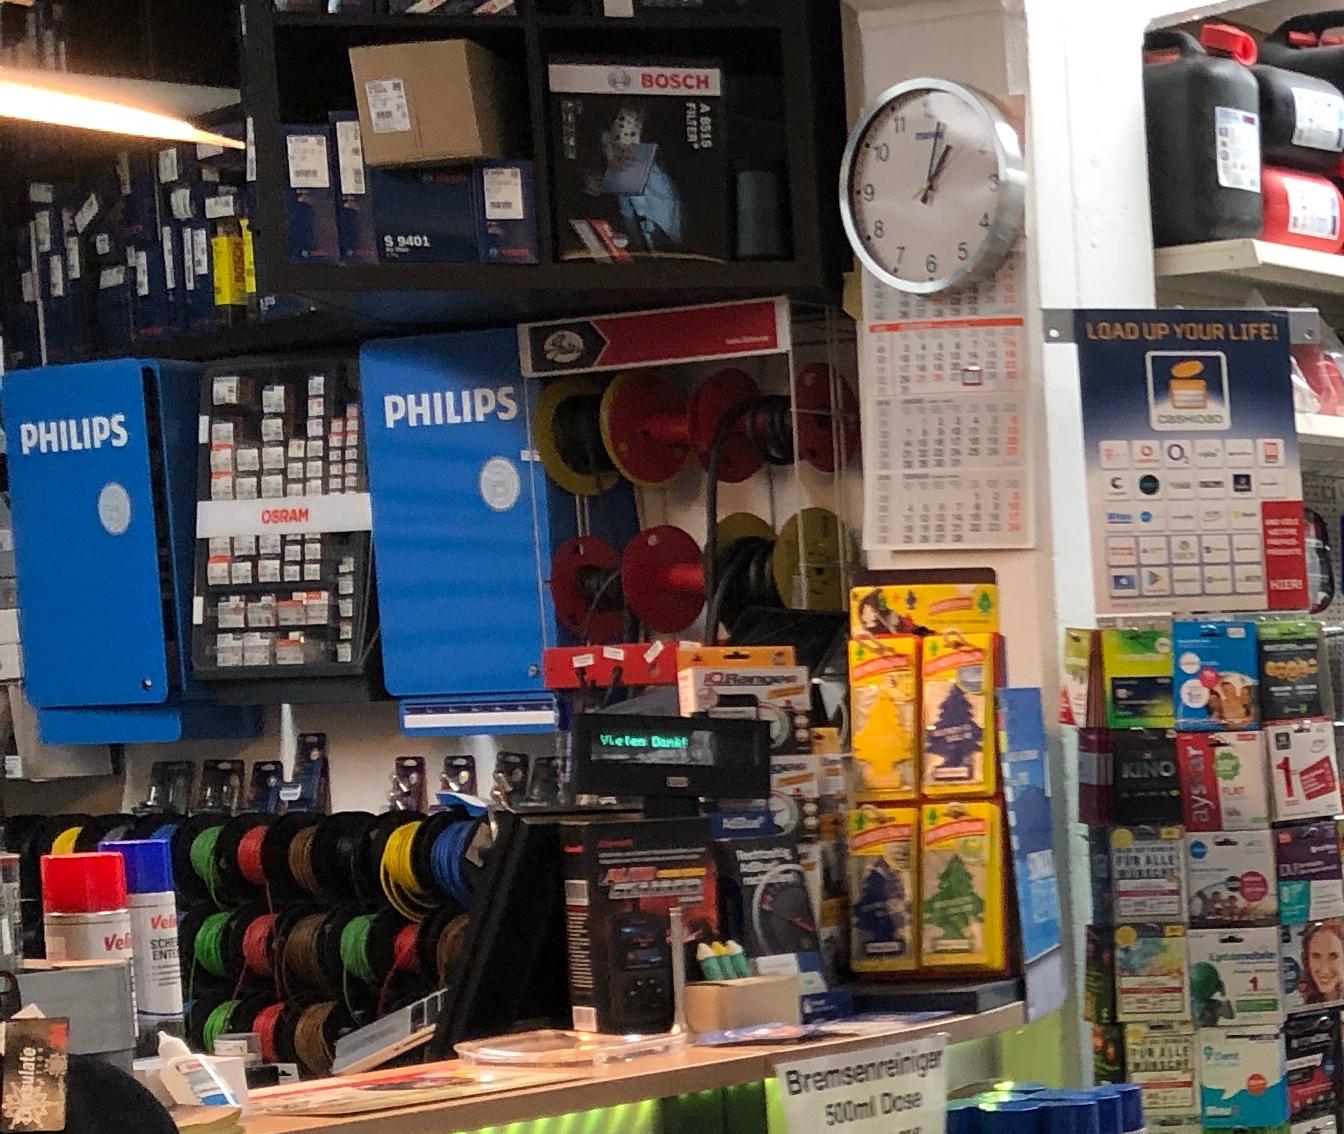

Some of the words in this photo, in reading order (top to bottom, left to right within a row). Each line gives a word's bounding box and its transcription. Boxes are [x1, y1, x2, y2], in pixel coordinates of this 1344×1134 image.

[641, 74, 710, 89] BOSCH
[894, 116, 906, 133] 11
[873, 143, 889, 162] 10
[988, 173, 999, 191] 3
[864, 184, 875, 201] 9
[874, 219, 884, 239] 8
[979, 212, 990, 228] 4
[896, 246, 905, 264] 7
[957, 241, 968, 260] 5
[233, 240, 245, 284] BOSCH
[926, 254, 937, 273] 6
[1086, 322, 1139, 341] LOAD
[1143, 322, 1169, 340] UP
[1173, 322, 1224, 340] YOUR
[1228, 322, 1279, 341] LIFE!
[384, 386, 518, 429] PHILIPS
[20, 414, 128, 455] PHILIPS
[261, 507, 310, 525] OSRAM
[600, 734, 647, 748] Vielen
[1121, 760, 1175, 778] KINO
[785, 1049, 943, 1096] Bremsenreiniger
[824, 1095, 875, 1126] 500ml
[880, 1091, 922, 1115] Dose
